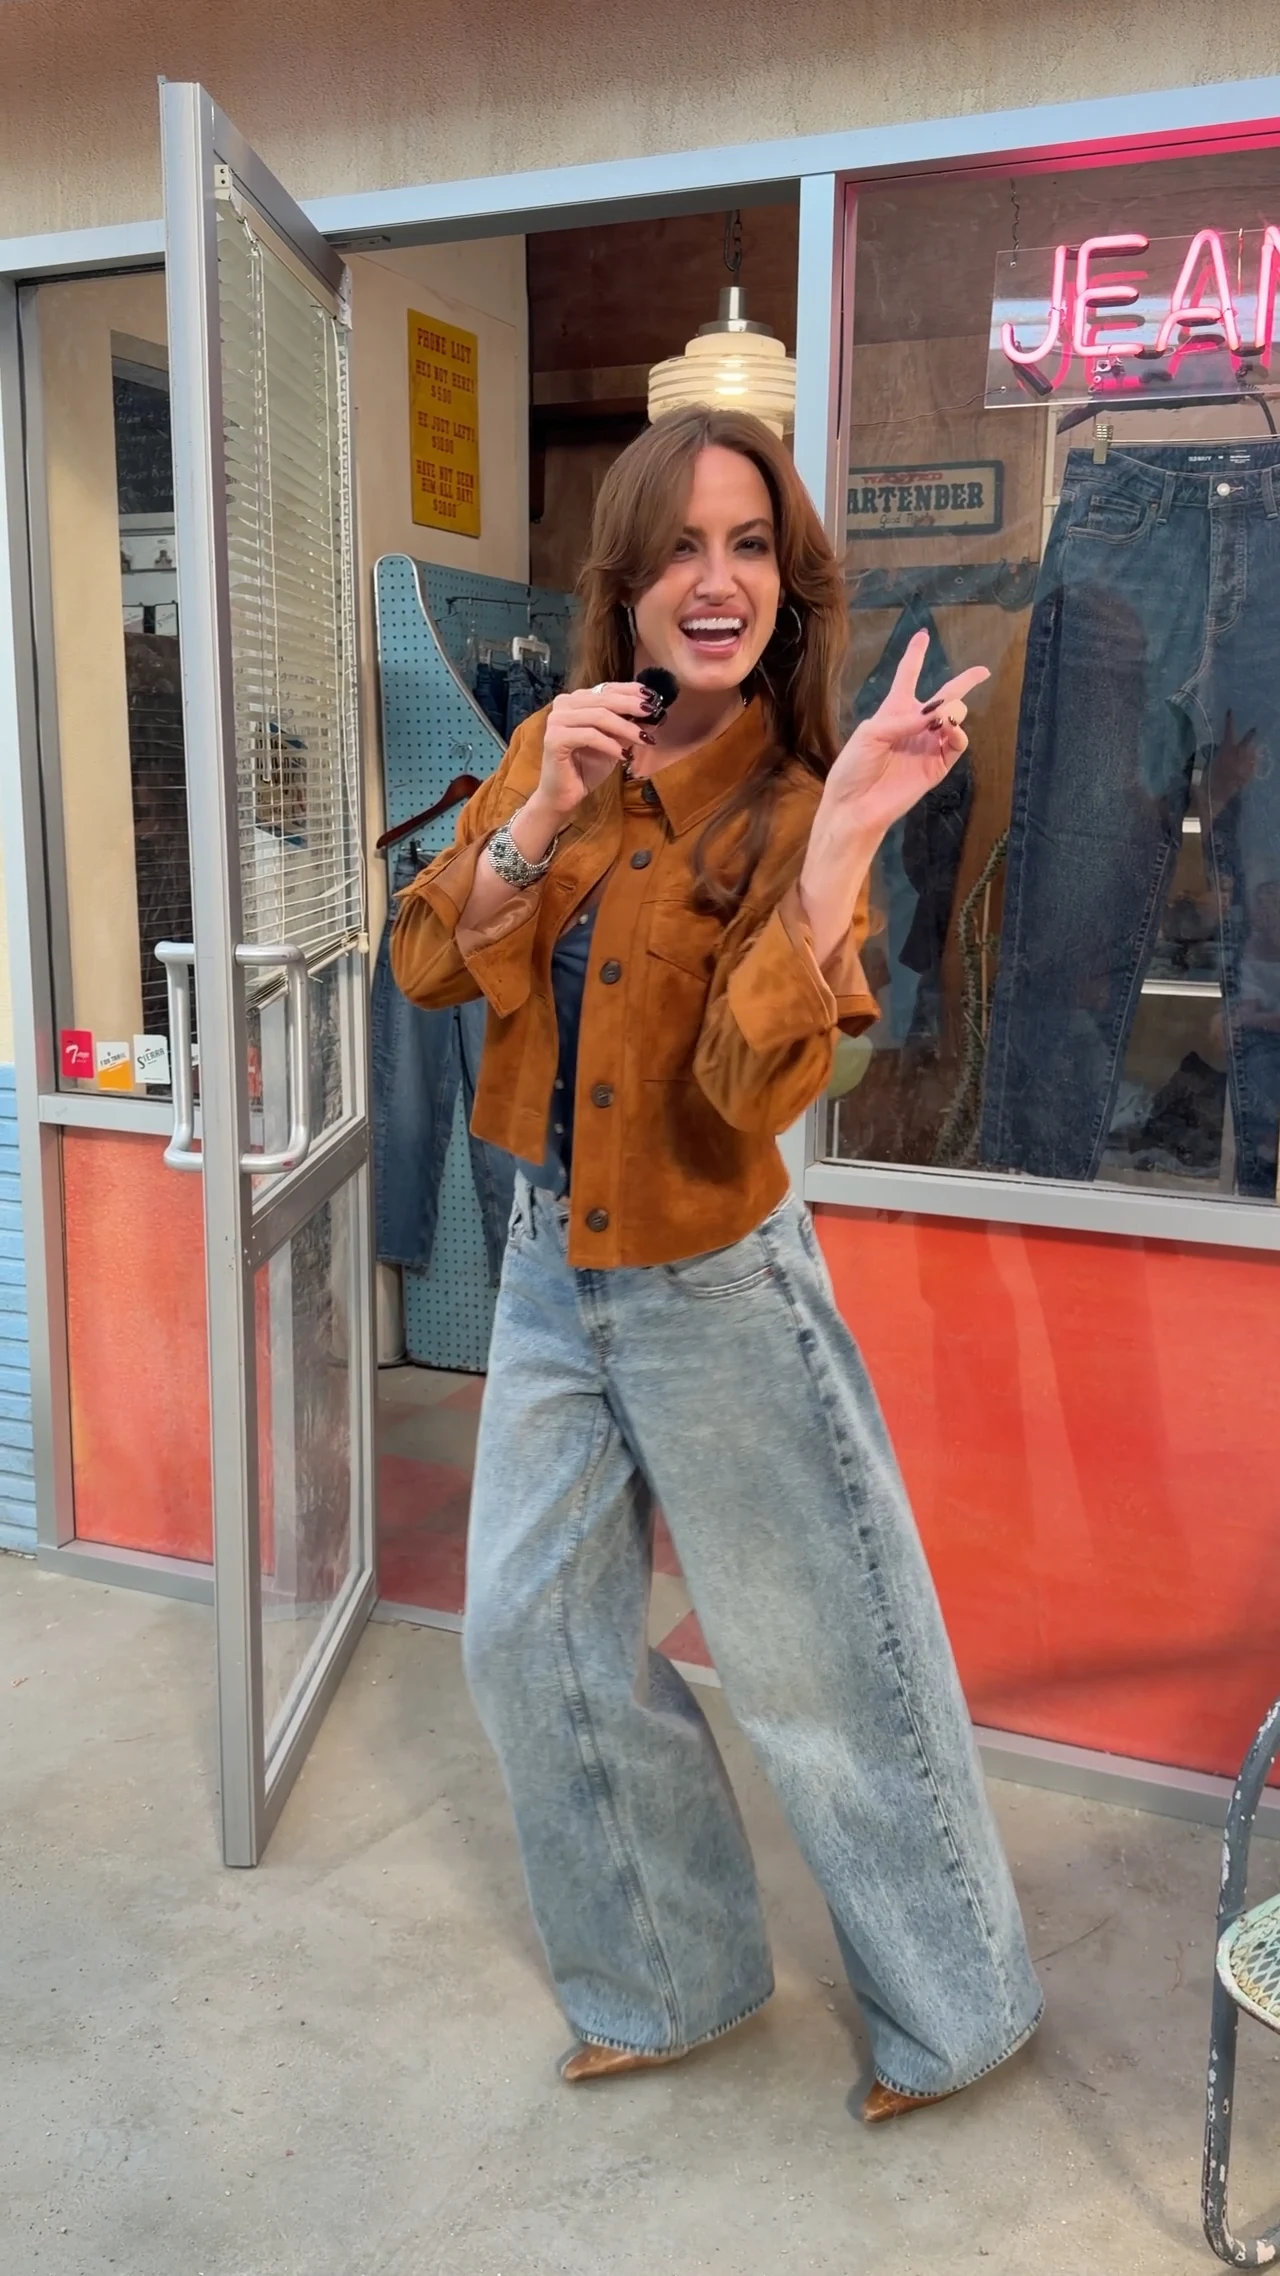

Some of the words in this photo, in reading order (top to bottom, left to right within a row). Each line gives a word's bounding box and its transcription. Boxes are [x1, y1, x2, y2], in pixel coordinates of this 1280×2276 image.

[1001, 225, 1280, 364] JEA
[417, 327, 447, 356] PHONE
[451, 340, 472, 364] LIST
